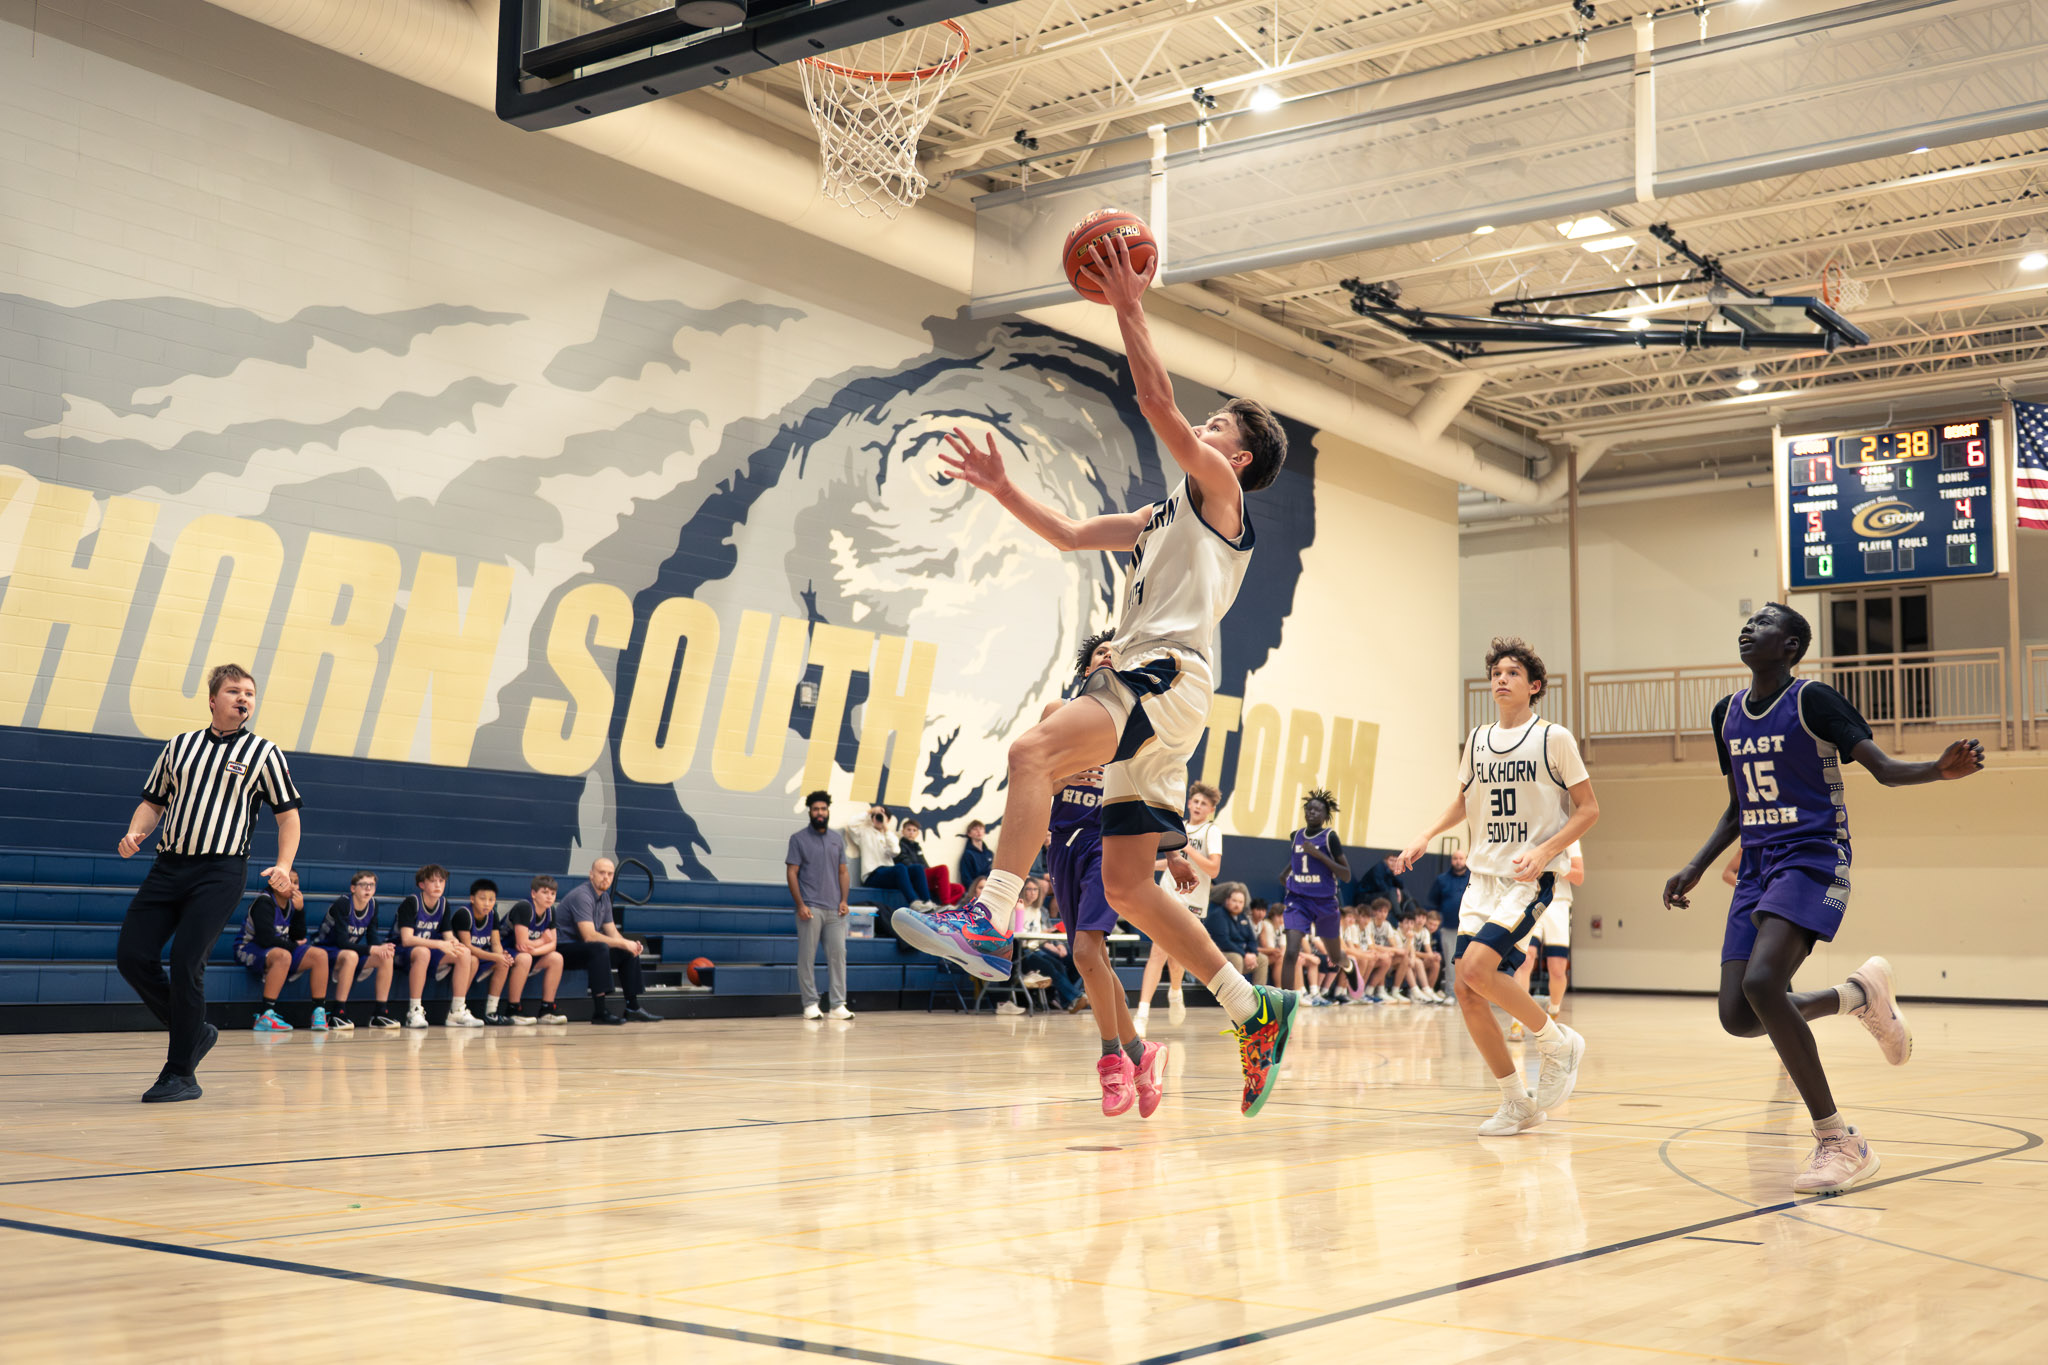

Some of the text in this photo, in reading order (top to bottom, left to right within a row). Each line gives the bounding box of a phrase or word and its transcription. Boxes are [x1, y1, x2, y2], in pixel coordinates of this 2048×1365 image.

[1118, 224, 1140, 237] PRO
[1861, 430, 1929, 462] 2:38
[1967, 440, 1985, 467] 6
[1808, 455, 1832, 483] 17
[1861, 472, 1895, 486] PERIOD
[1906, 467, 1913, 488] 1
[1937, 471, 1970, 484] BONUS
[1807, 483, 1838, 496] BONUS
[1939, 485, 1987, 499] TIMEOUTS
[1793, 499, 1838, 513] TIMEOUTS
[1955, 497, 1972, 519] 4
[1808, 510, 1823, 533] 5
[1883, 511, 1925, 525] STORM
[1952, 518, 1976, 530] LEFT
[1804, 530, 1826, 543] LEFT
[1858, 536, 1928, 552] PLAYER FOULS
[1946, 532, 1977, 545] FOULS
[1804, 544, 1833, 556] FOULS
[1969, 543, 1977, 564] 1
[1818, 555, 1833, 577] 0
[0, 475, 1380, 849] HORN SOUTH TORM
[1729, 734, 1785, 756] EAST
[1476, 760, 1537, 783] ELKHORN
[1742, 760, 1780, 802] 15
[1490, 788, 1517, 816] 30
[1742, 806, 1798, 826] HIGH
[1487, 822, 1528, 843] SOUTH
[1302, 854, 1309, 873] 1
